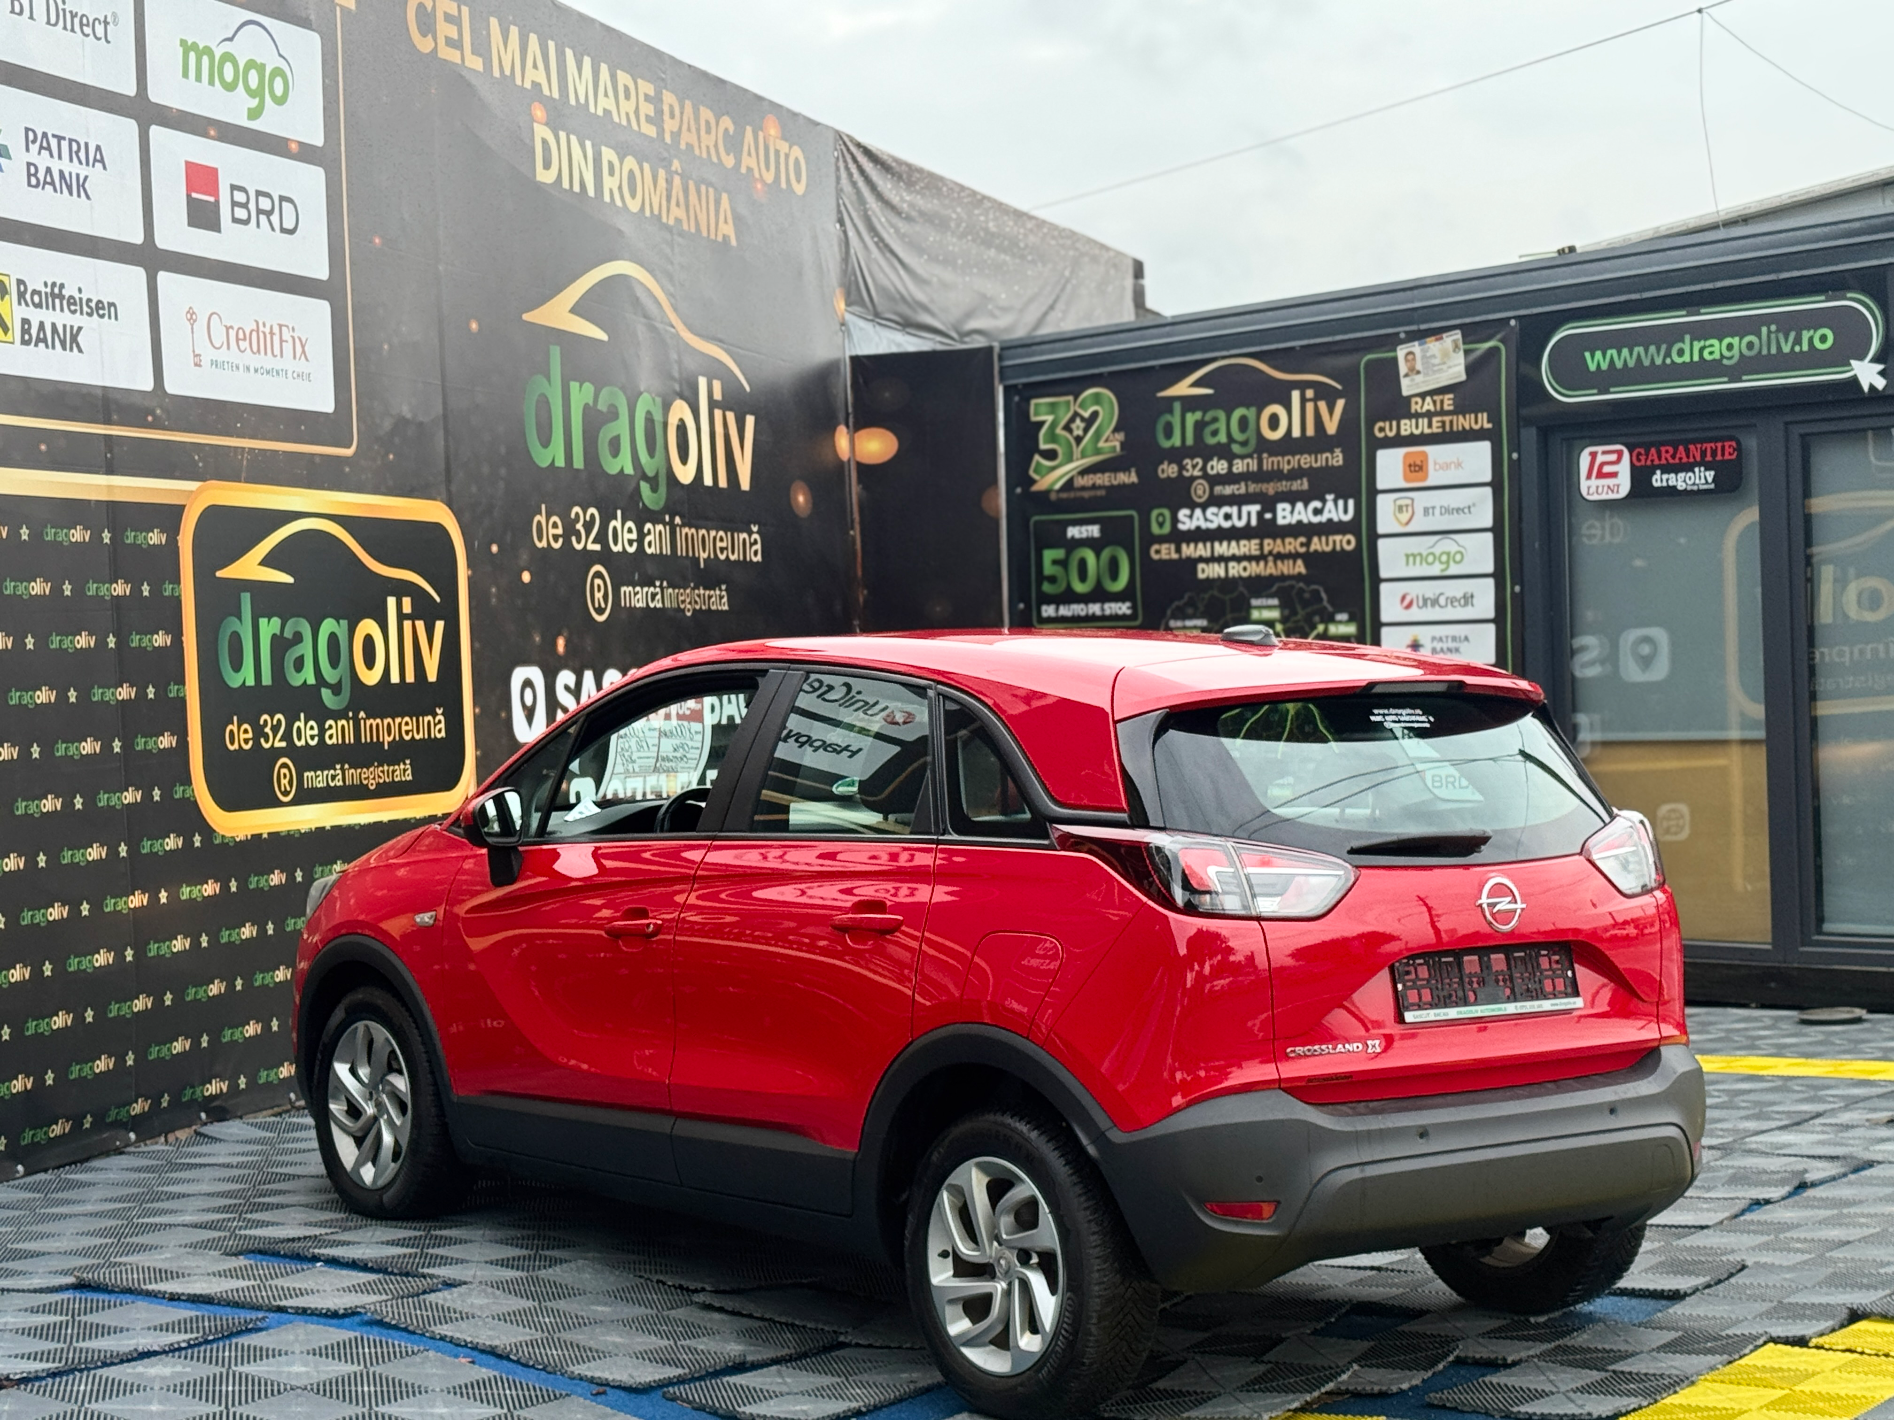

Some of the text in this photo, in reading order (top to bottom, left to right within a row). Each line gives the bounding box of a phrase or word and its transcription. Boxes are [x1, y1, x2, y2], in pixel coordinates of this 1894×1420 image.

[179, 38, 290, 121] mogo
[407, 0, 807, 195] CEL MAI MARE PARC AUTO
[24, 126, 108, 171] PATRIA
[26, 162, 92, 201] BANK
[533, 121, 737, 246] DIN ROMÂNIA
[229, 183, 300, 235] BRD
[16, 278, 119, 322] Raiffeisen
[20, 318, 84, 354] BANK
[206, 311, 310, 362] CreditFix
[1584, 324, 1834, 372] www.dragoliv.ro
[210, 359, 240, 373] PRIETEN
[253, 364, 289, 380] MOMENTE
[291, 369, 312, 383] CHEIE
[1410, 394, 1455, 413] RATE
[523, 345, 755, 511] dragoliv
[1156, 388, 1346, 455] dragoliv
[1374, 413, 1492, 437] CU BULETINUL
[1158, 448, 1343, 478] de 32 de ani împreună
[1408, 459, 1464, 473] tbi bank
[1585, 449, 1624, 481] 12
[1631, 441, 1738, 466] GARANTIE
[1214, 482, 1246, 496] marcă
[1586, 484, 1621, 496] LUNI
[1652, 466, 1715, 490] dragoliv
[1177, 504, 1261, 531] SASCUT
[1276, 494, 1354, 525] BACĂU
[1397, 504, 1410, 514] BT
[1423, 506, 1436, 517] BT
[43, 524, 167, 548] dragoliv dragoliv
[532, 504, 762, 568] de 32 de ani împreună
[1067, 524, 1101, 539] PESTE
[1150, 534, 1356, 560] CEL MAI MARE PARC AUTO
[1041, 545, 1130, 595] 500
[1197, 558, 1307, 579] DIN ROMÂNIA
[1404, 550, 1464, 572] mogo
[3, 577, 51, 599] dragoliv
[85, 579, 131, 600] dragoliv
[620, 581, 663, 608] marcă
[663, 582, 729, 616] înregistrată
[1416, 591, 1475, 610] UniCredit
[1041, 602, 1132, 618] DE AUTO PE STOC
[49, 630, 172, 653] dragoliv dragoliv
[218, 592, 445, 710] dragoliv
[1431, 634, 1470, 644] PATRIA
[1431, 646, 1461, 655] BANK
[8, 686, 56, 708] dragoliv
[90, 683, 136, 705] dragoliv
[225, 707, 446, 750] de 32 de ani împreună
[54, 737, 101, 759] dragoliv
[134, 732, 177, 753] dragoliv
[303, 763, 343, 789] marcă
[344, 759, 413, 791] înregistrată
[14, 795, 62, 817] dragoliv
[96, 787, 142, 810] dragoliv
[60, 843, 107, 866] dragoliv
[140, 833, 183, 855] dragoliv
[20, 904, 69, 928] dragoliv
[103, 890, 149, 913] dragoliv
[179, 879, 221, 901] dragoliv
[248, 870, 286, 891] dragoliv
[66, 948, 114, 972] dragoliv
[147, 935, 191, 958] dragoliv
[219, 922, 258, 945] dragoliv
[24, 965, 292, 1036] dragoliv dragoliv dragoliv dragoliv
[68, 1054, 115, 1080] dragoliv
[147, 1036, 191, 1061] dragoliv
[221, 1020, 262, 1044] dragoliv
[1286, 1040, 1381, 1057] CROSSLAND X
[20, 1061, 296, 1146] dragoliv dragoliv dragoliv dragoliv
